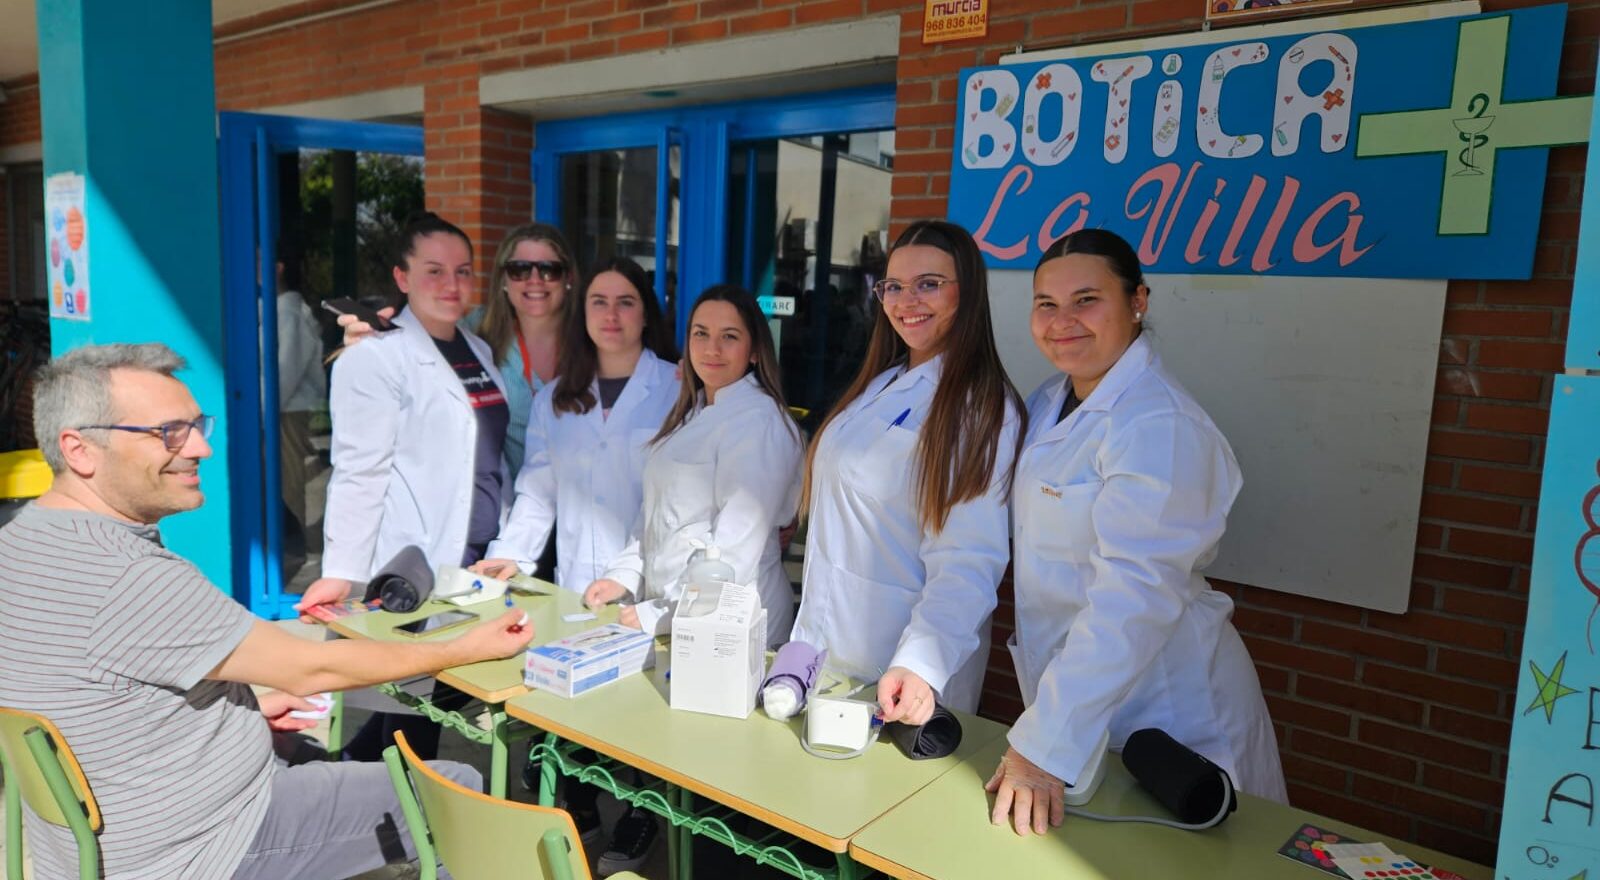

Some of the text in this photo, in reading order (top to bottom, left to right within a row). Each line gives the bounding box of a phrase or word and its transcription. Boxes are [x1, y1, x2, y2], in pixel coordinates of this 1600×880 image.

[932, 0, 981, 17] murcia
[925, 19, 945, 32] 968
[946, 16, 965, 29] 836
[967, 14, 986, 26] 404
[972, 161, 1382, 272] La Villa
